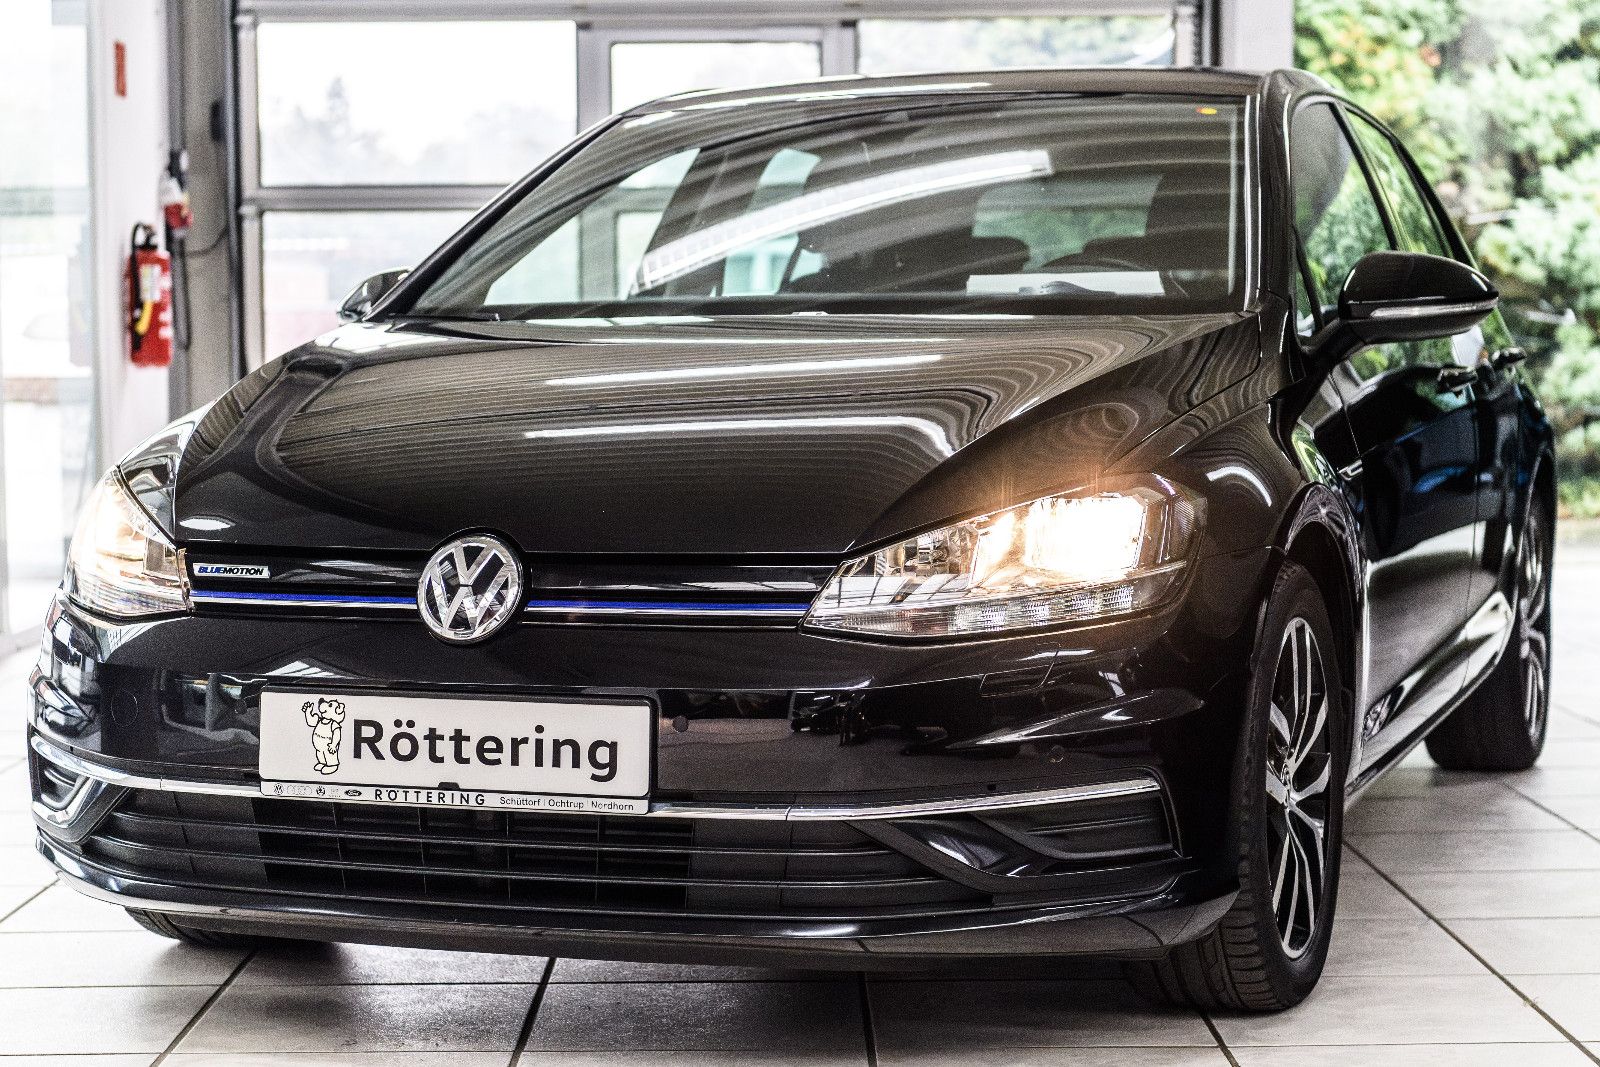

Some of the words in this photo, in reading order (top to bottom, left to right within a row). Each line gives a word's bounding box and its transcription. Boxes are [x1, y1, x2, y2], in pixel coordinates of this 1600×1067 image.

[197, 566, 264, 576] BLUEMOTION
[353, 718, 618, 782] Röttering
[374, 788, 486, 806] RÖTTERING
[499, 796, 541, 807] Schüttorf
[548, 798, 584, 810] Ochtrup
[591, 800, 634, 811] Nordhorn
